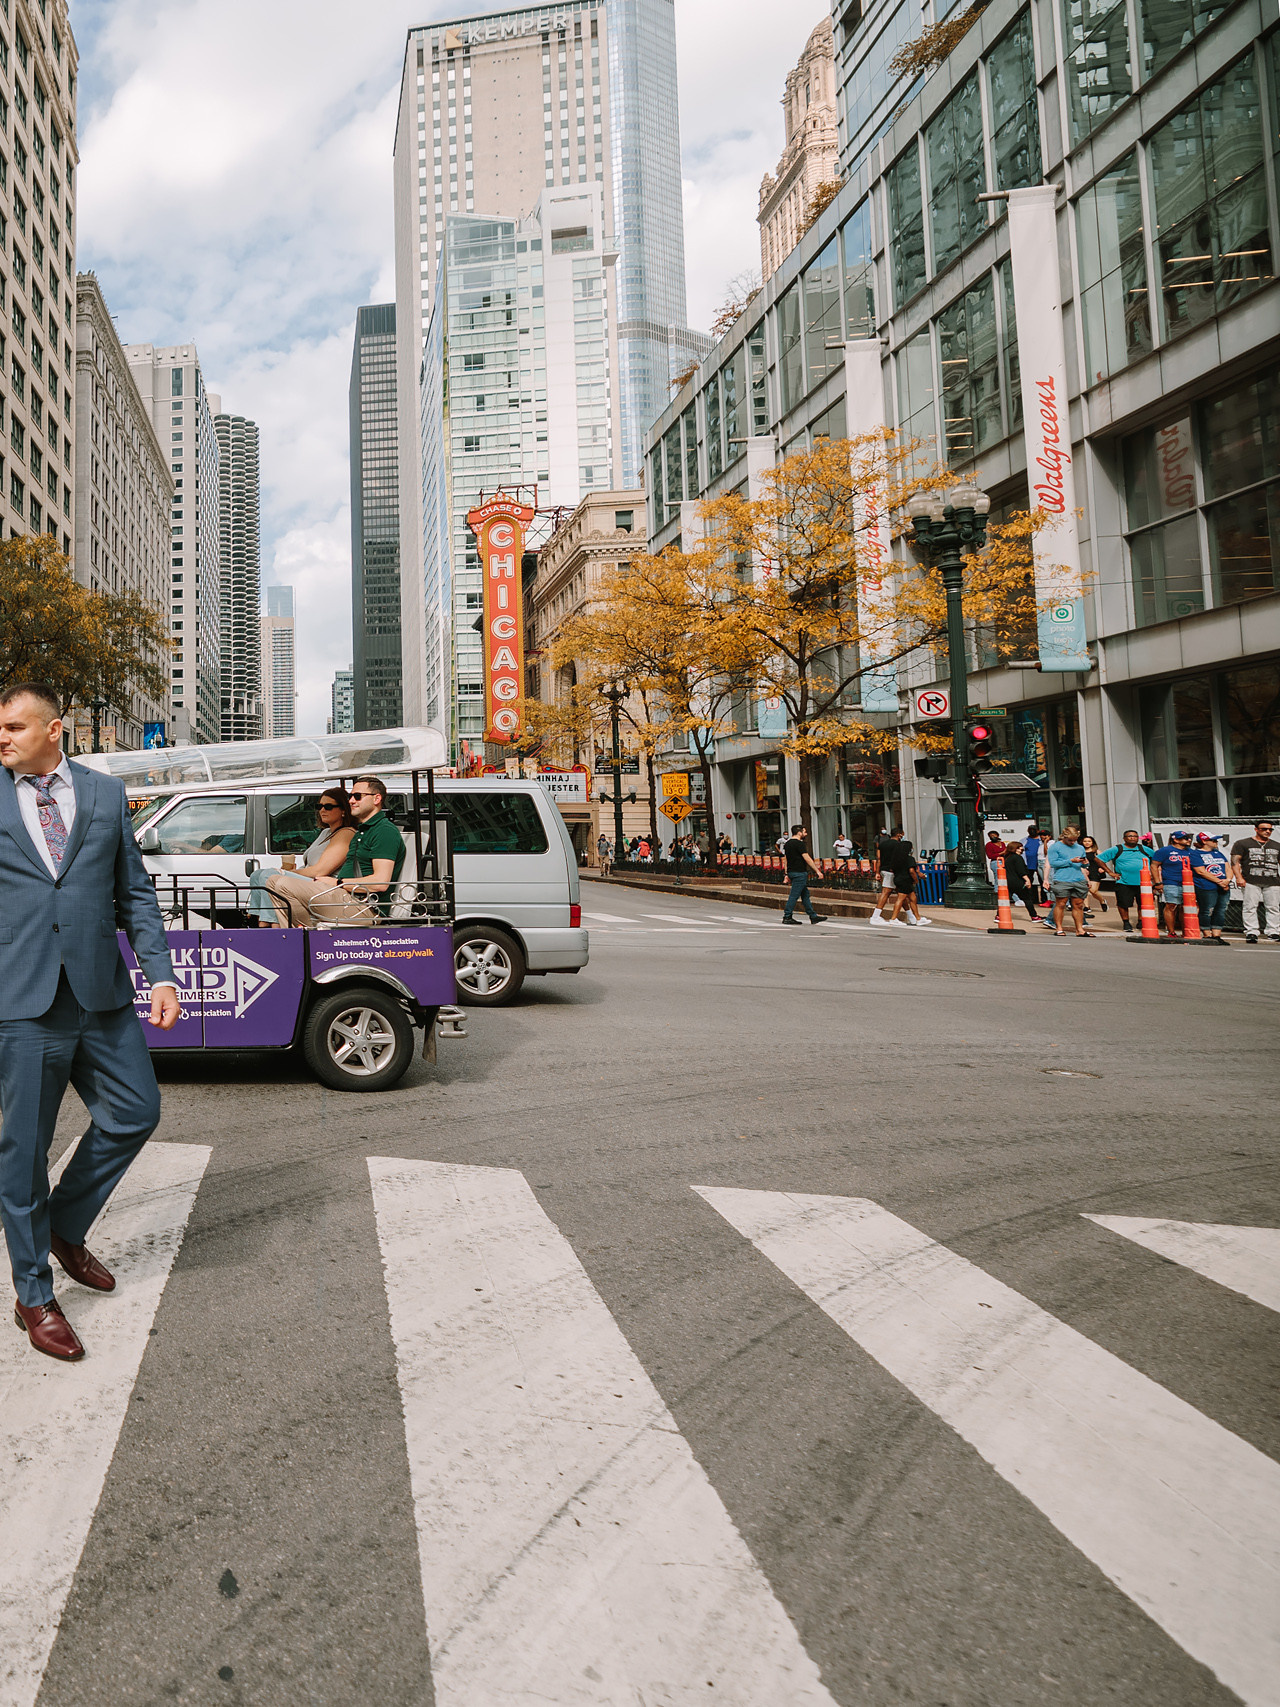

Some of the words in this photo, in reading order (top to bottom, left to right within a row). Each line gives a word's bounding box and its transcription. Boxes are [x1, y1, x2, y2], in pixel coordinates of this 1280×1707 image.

[468, 13, 567, 43] KEMPER
[1033, 375, 1072, 514] Walgreens
[480, 504, 512, 518] CHASE
[488, 523, 520, 733] CHICAGO
[1050, 625, 1076, 634] photo
[333, 939, 370, 947] alzheimer's
[382, 938, 419, 946] association
[198, 947, 226, 967] TO
[316, 951, 335, 962] Sign
[335, 951, 349, 961] Up
[350, 949, 374, 961] today
[374, 950, 384, 959] at
[384, 948, 435, 960] alz.org/walk
[134, 990, 228, 1002] ALEIMER'S
[190, 1008, 232, 1018] association
